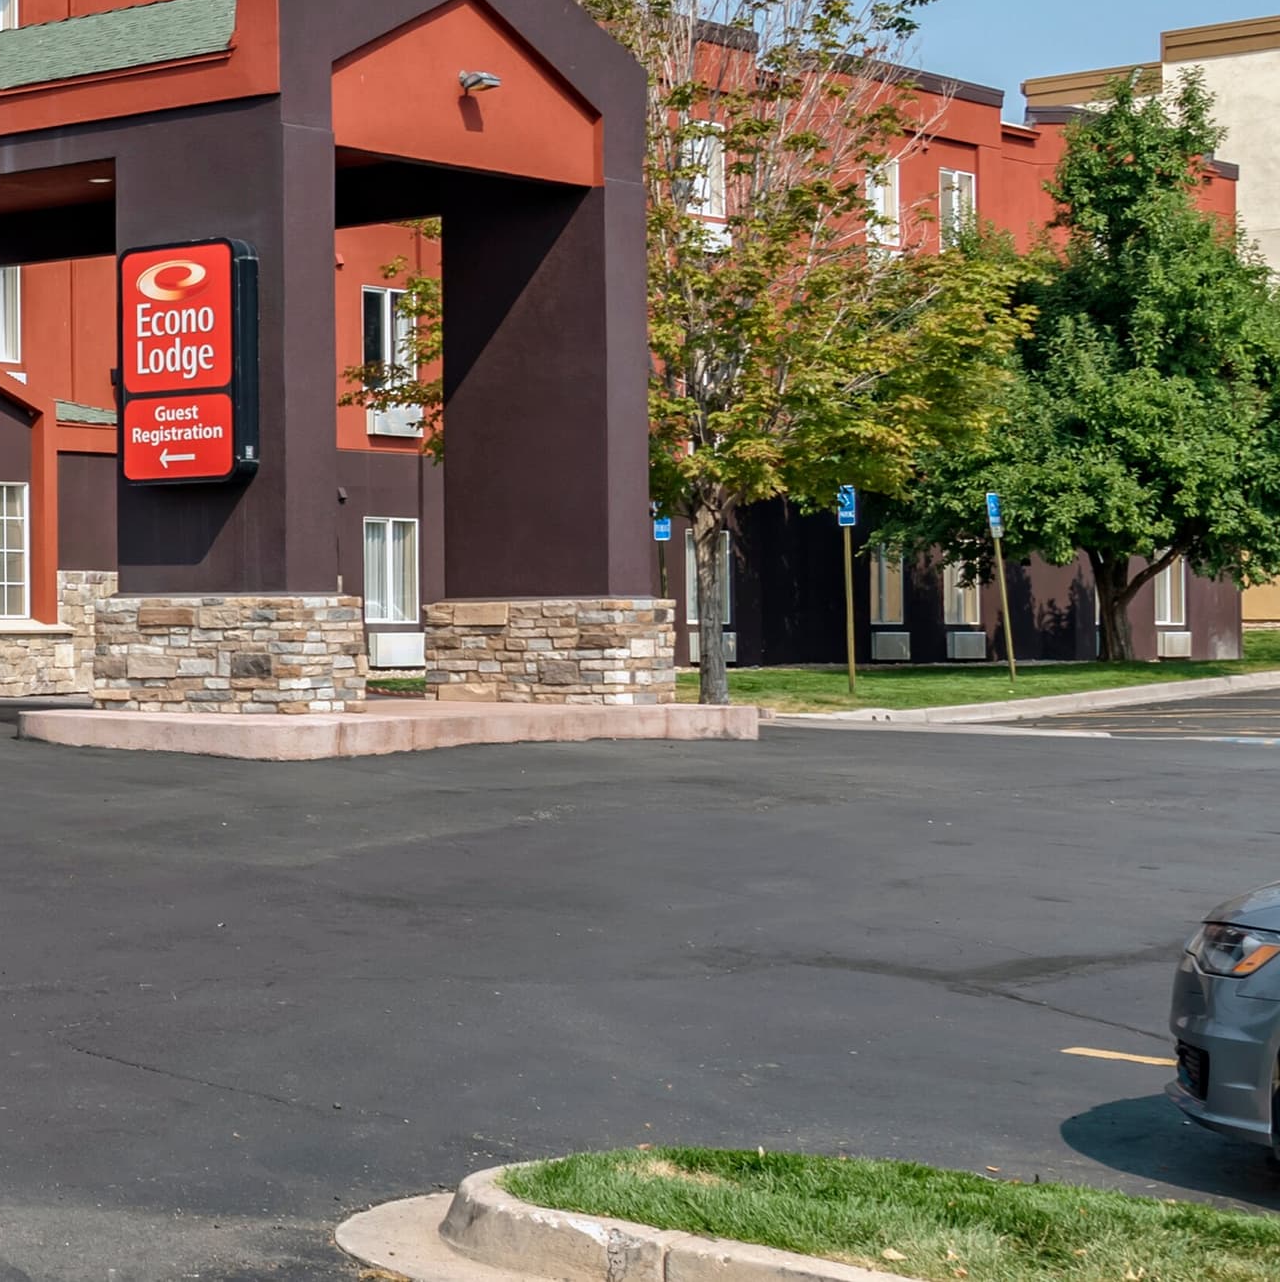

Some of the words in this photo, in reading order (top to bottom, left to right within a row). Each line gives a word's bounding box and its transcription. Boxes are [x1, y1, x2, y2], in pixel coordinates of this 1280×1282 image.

[136, 303, 214, 337] Econo
[136, 338, 214, 379] Lodge
[154, 405, 199, 422] Guest
[132, 424, 223, 446] Registration
